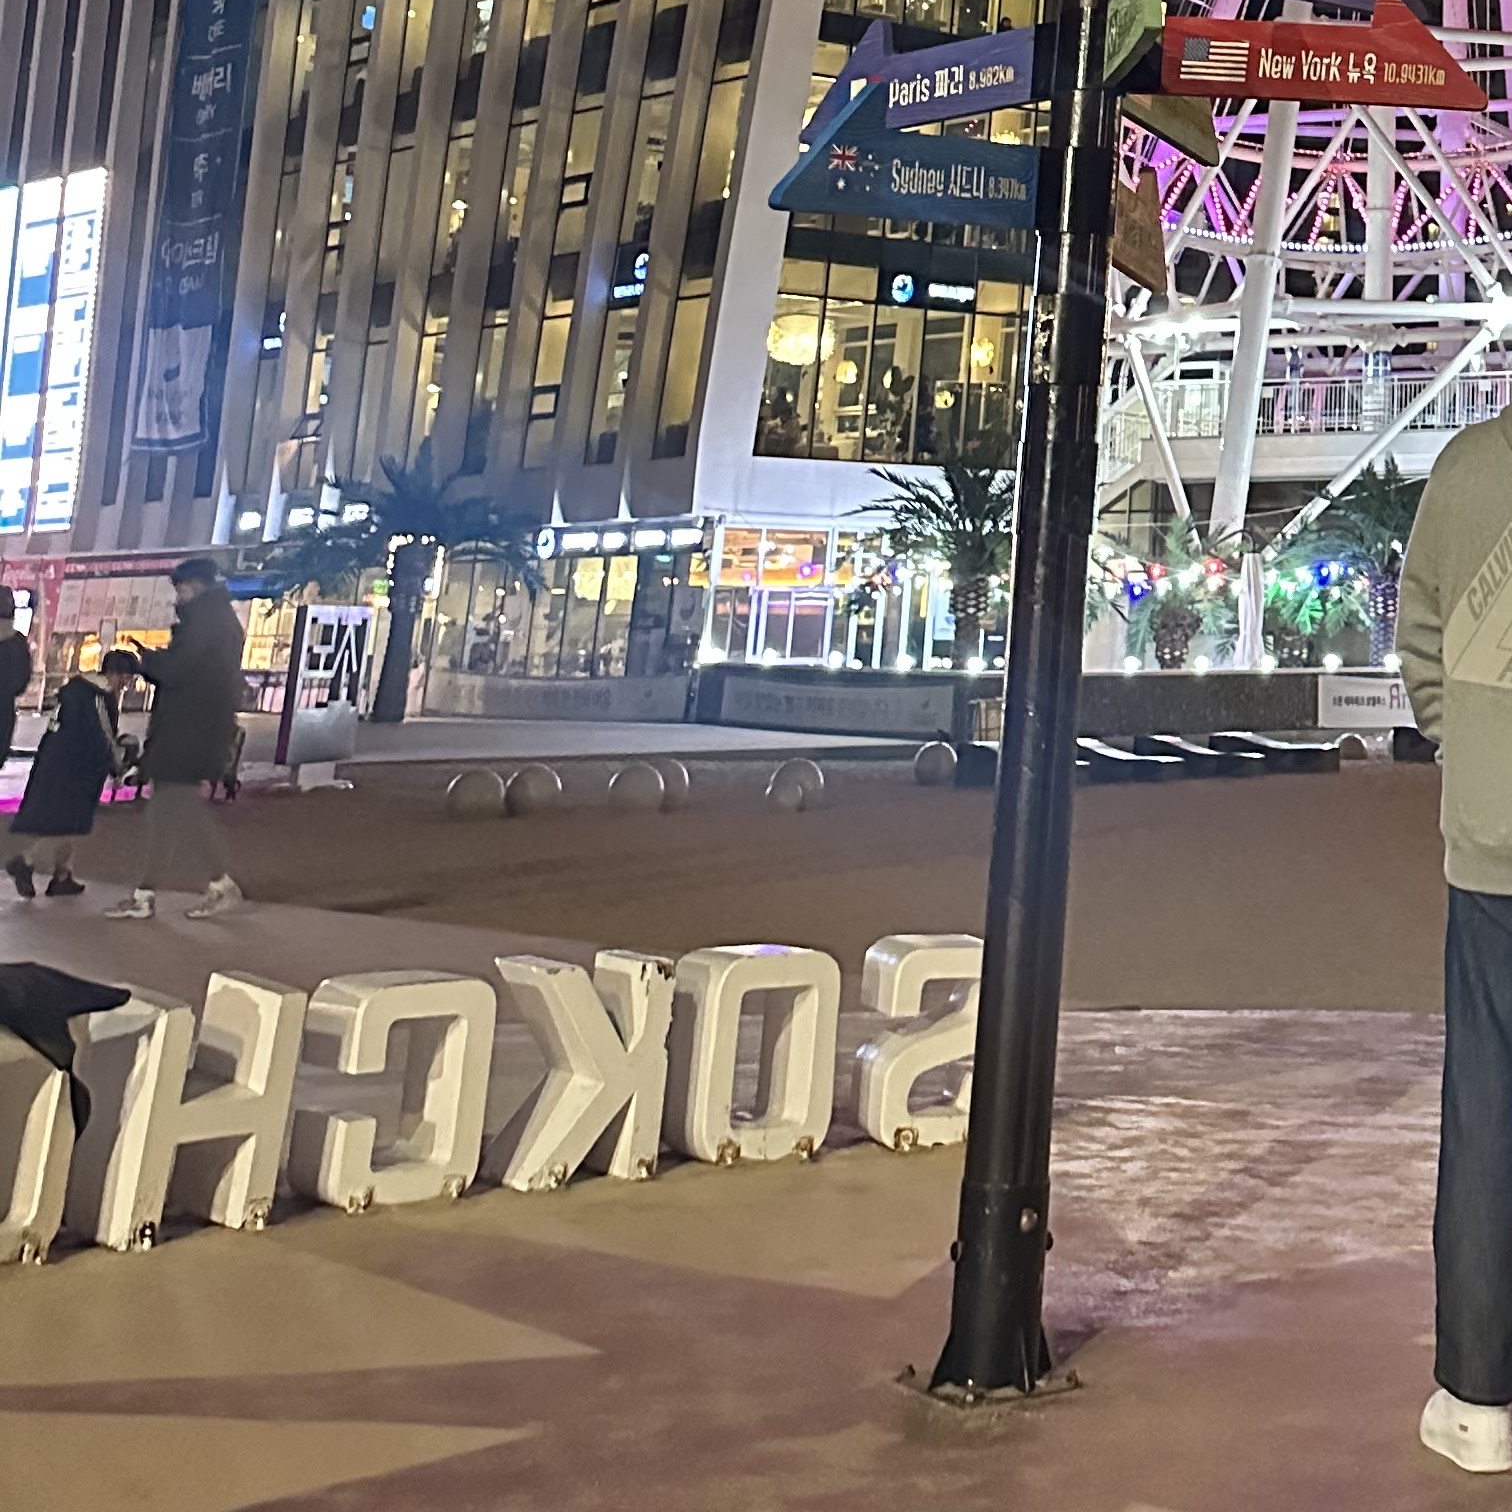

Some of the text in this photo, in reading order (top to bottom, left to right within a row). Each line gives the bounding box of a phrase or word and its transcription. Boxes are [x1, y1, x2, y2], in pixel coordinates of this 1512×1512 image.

[888, 73, 930, 109] Paris
[933, 63, 965, 99] 파리
[1258, 47, 1297, 81] New
[1301, 50, 1343, 83] York
[1346, 51, 1377, 85] 뉴욕
[890, 158, 945, 198] Sydney
[947, 163, 985, 200] 시드니
